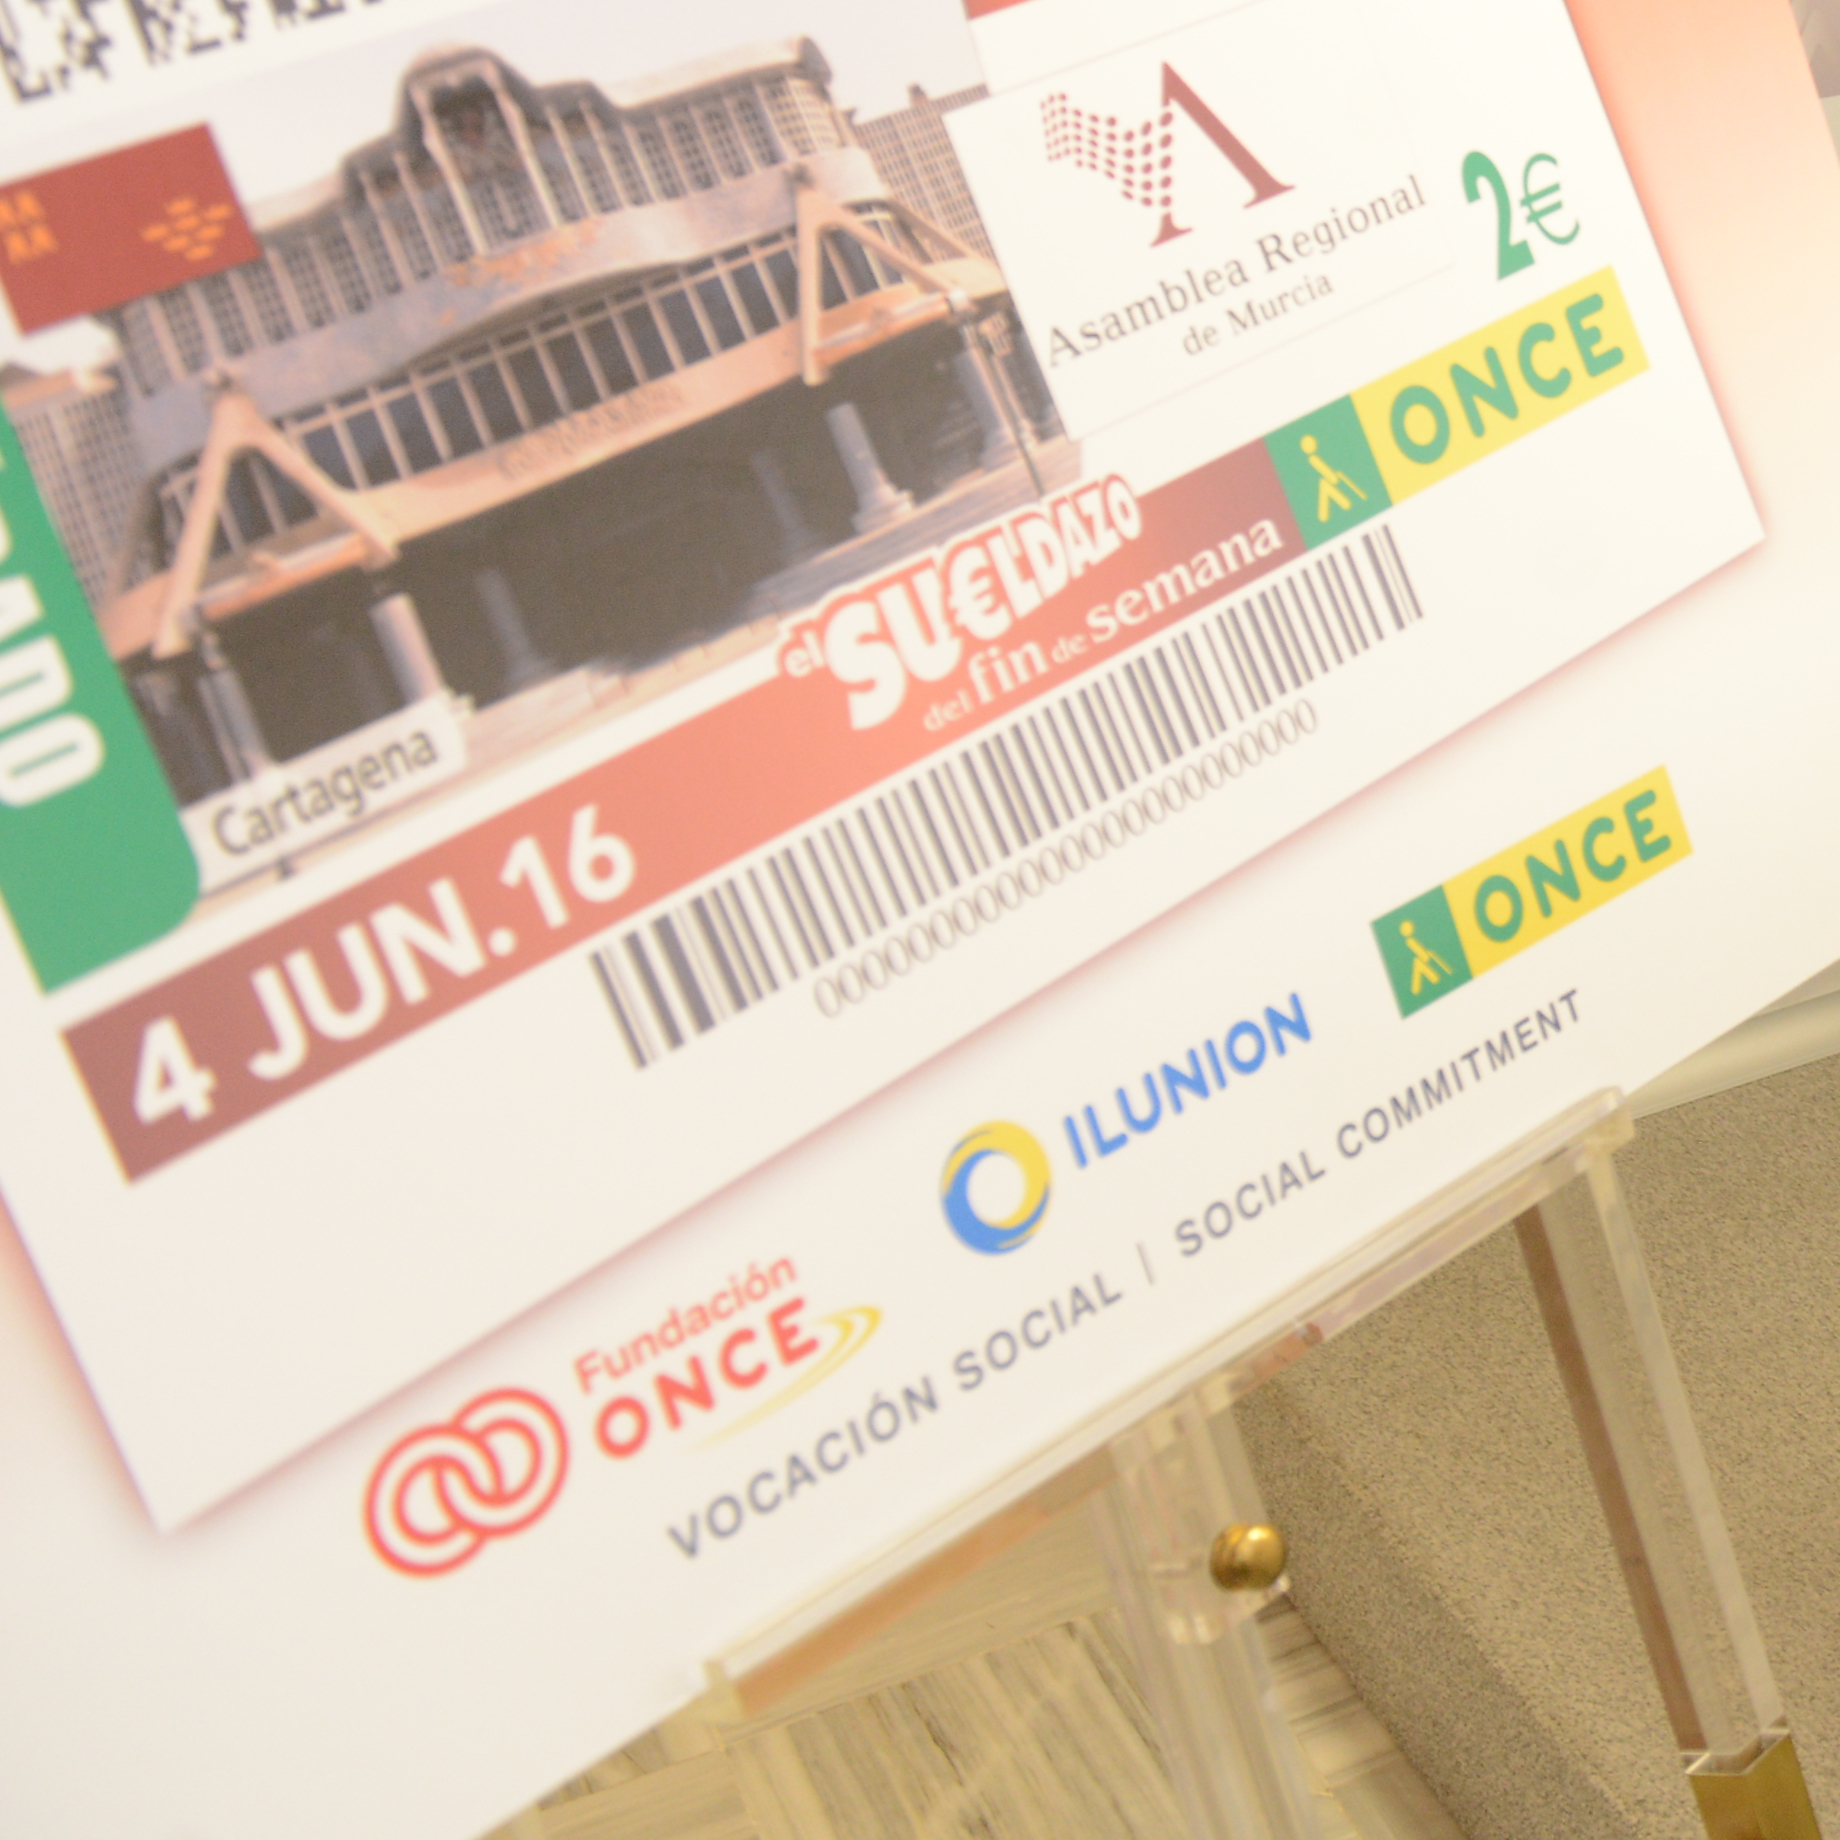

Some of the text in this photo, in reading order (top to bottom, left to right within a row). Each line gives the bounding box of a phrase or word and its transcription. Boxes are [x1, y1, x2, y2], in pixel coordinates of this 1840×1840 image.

[1046, 173, 1428, 368] Asamblea Regional
[1461, 150, 1581, 281] 2€
[1181, 269, 1335, 357] de Murcia
[1389, 292, 1625, 465] ONCE
[784, 630, 825, 678] el
[923, 518, 1285, 733] del fin de semana
[211, 727, 439, 857] Cartagena
[1473, 788, 1672, 943] ONCE
[131, 1017, 216, 1125] 4
[1062, 992, 1313, 1169] ILUNION
[574, 1257, 799, 1394] Fundación
[667, 990, 1582, 1560] VOCACIÓN SOCIAL SOCIAL COMMITMENT
[594, 1296, 820, 1459] ONCE
